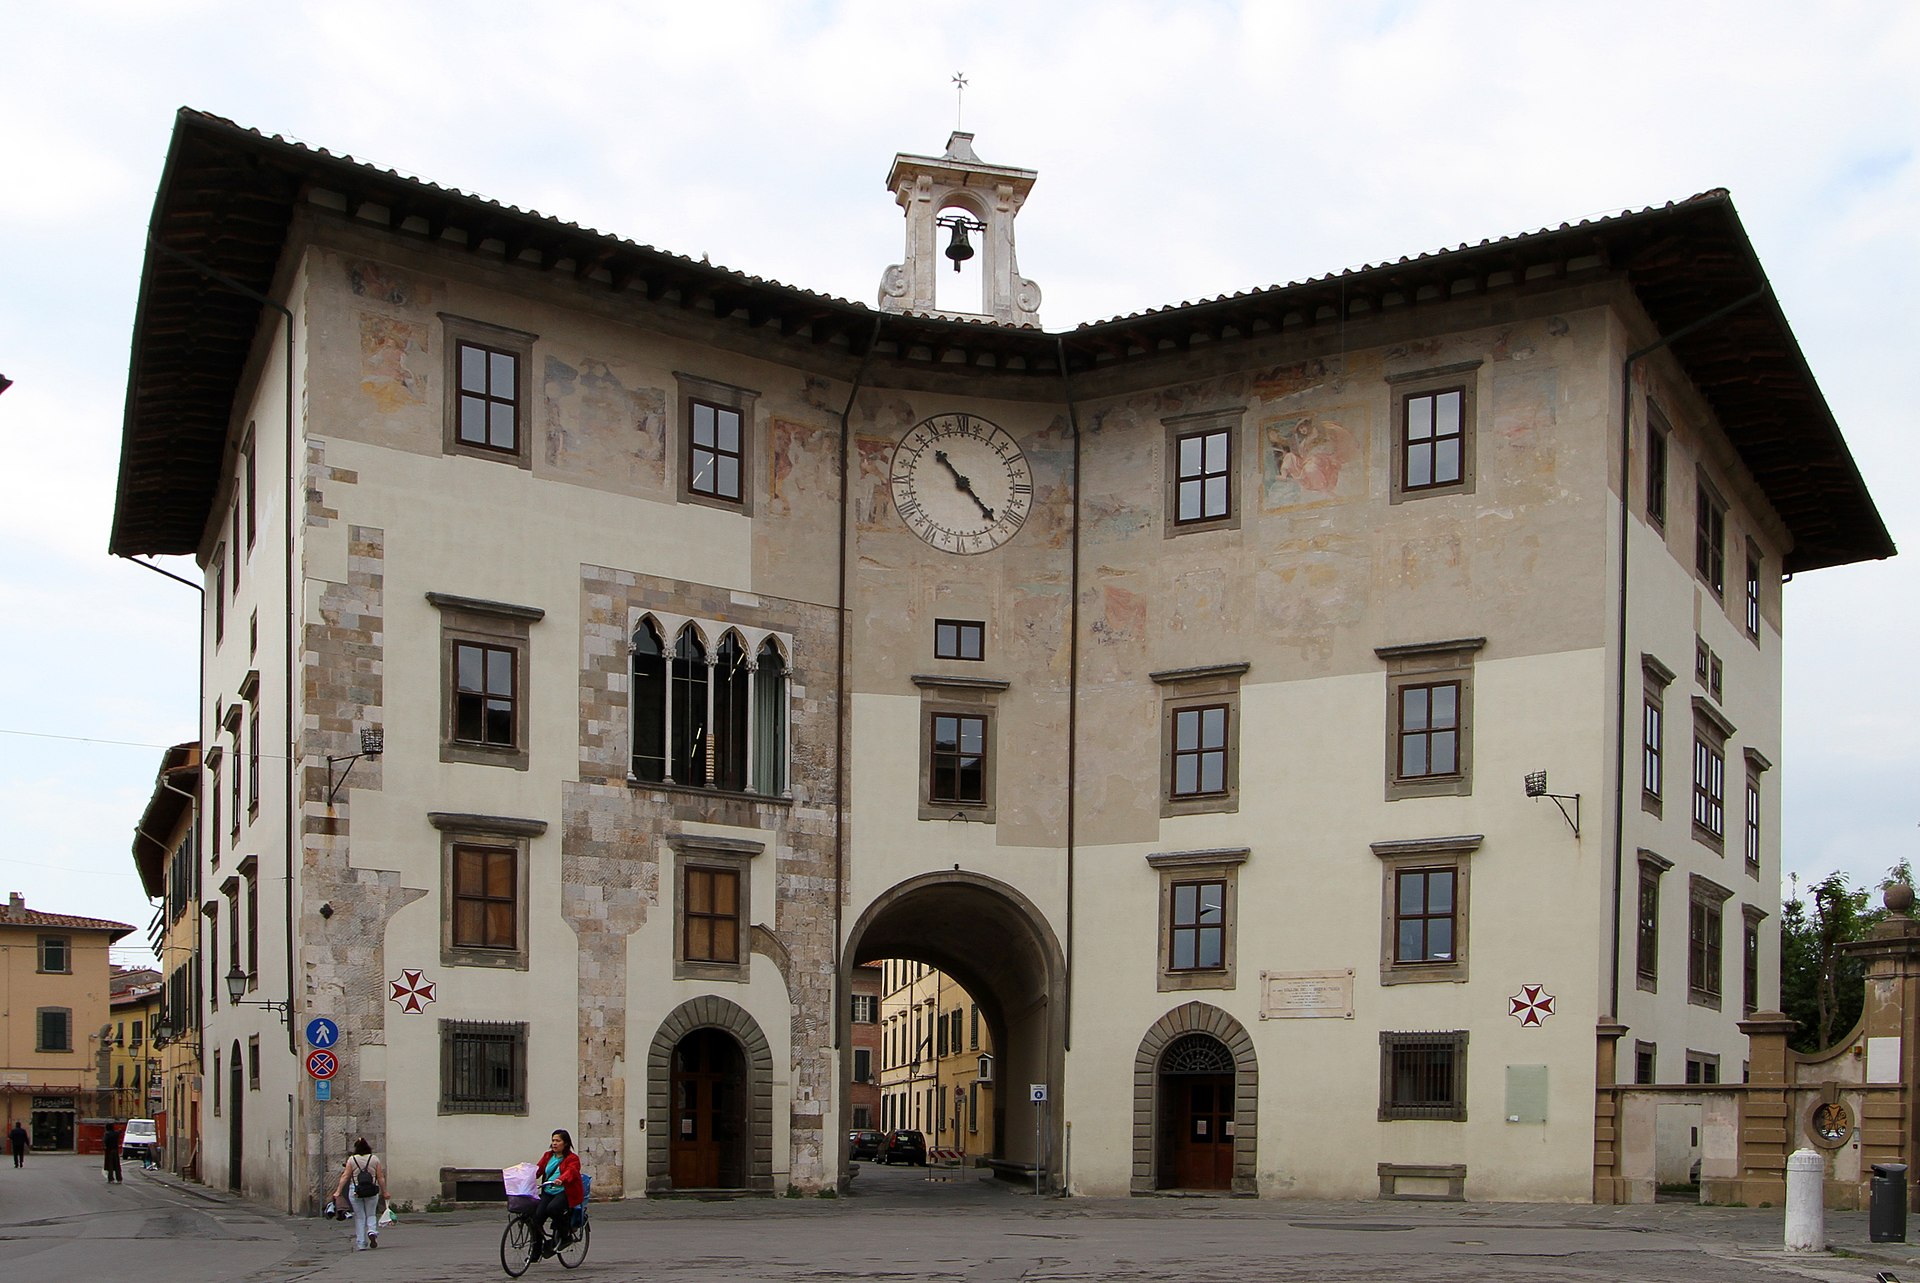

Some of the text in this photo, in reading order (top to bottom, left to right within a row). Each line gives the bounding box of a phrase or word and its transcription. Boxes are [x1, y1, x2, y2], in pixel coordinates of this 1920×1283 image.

[924, 420, 939, 437] XI
[956, 415, 969, 433] XII
[988, 427, 998, 441] I
[901, 442, 917, 456] X
[1007, 453, 1022, 464] II
[892, 473, 909, 484] IX
[1015, 484, 1031, 494] III
[898, 501, 916, 519] VIII
[1006, 509, 1024, 528] IIII
[922, 525, 936, 544] VII
[988, 532, 999, 548] V
[956, 537, 966, 553] VI
